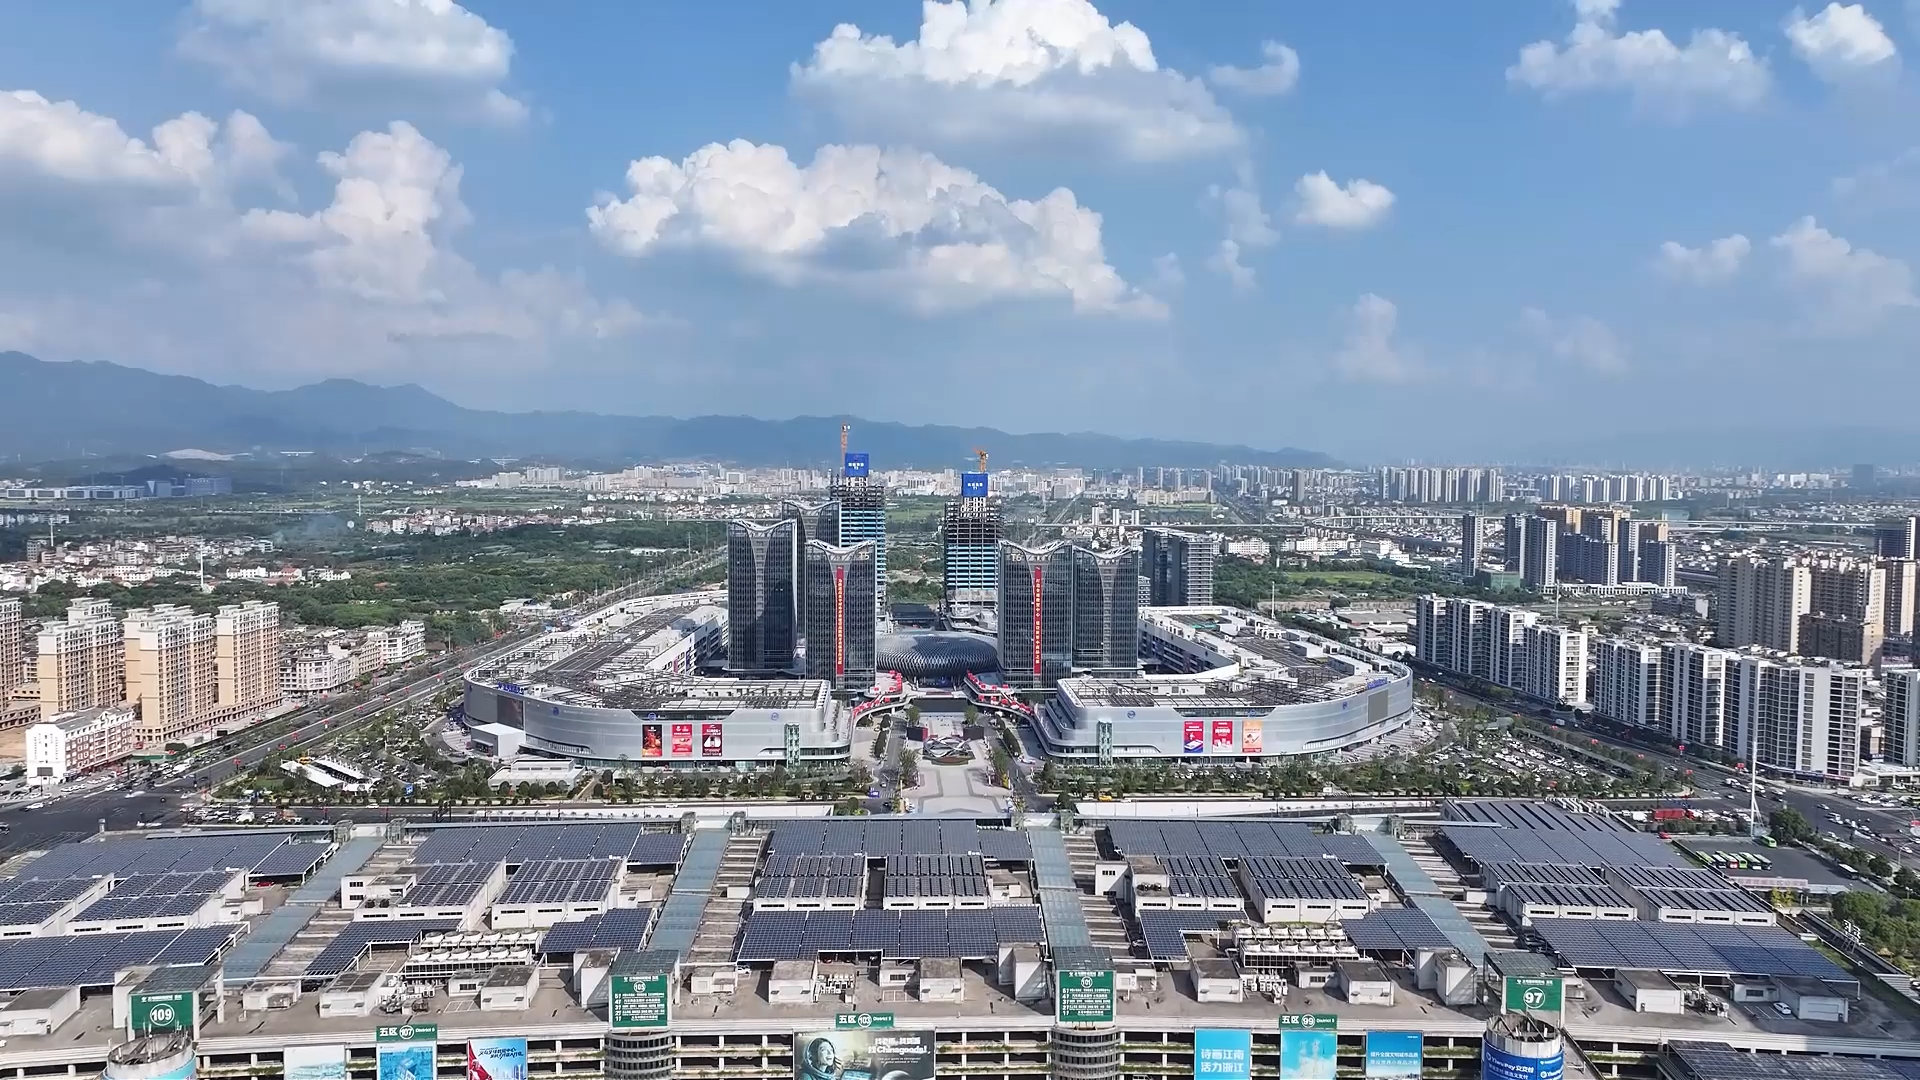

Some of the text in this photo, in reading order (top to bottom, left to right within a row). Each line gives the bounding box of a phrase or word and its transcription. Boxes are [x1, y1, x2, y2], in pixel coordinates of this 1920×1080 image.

[858, 552, 870, 561] T5
[1010, 553, 1022, 562] T6
[1525, 992, 1542, 1004] 97
[151, 1009, 173, 1022] 109
[838, 1015, 857, 1024] 五区
[859, 1016, 872, 1025] 103
[1281, 1015, 1300, 1024] 五区
[1302, 1017, 1315, 1025] 99
[379, 1027, 398, 1037] 五区
[400, 1027, 413, 1037] 107
[1201, 1049, 1244, 1060] 诗画江南
[1201, 1062, 1244, 1073] 活力浙江
